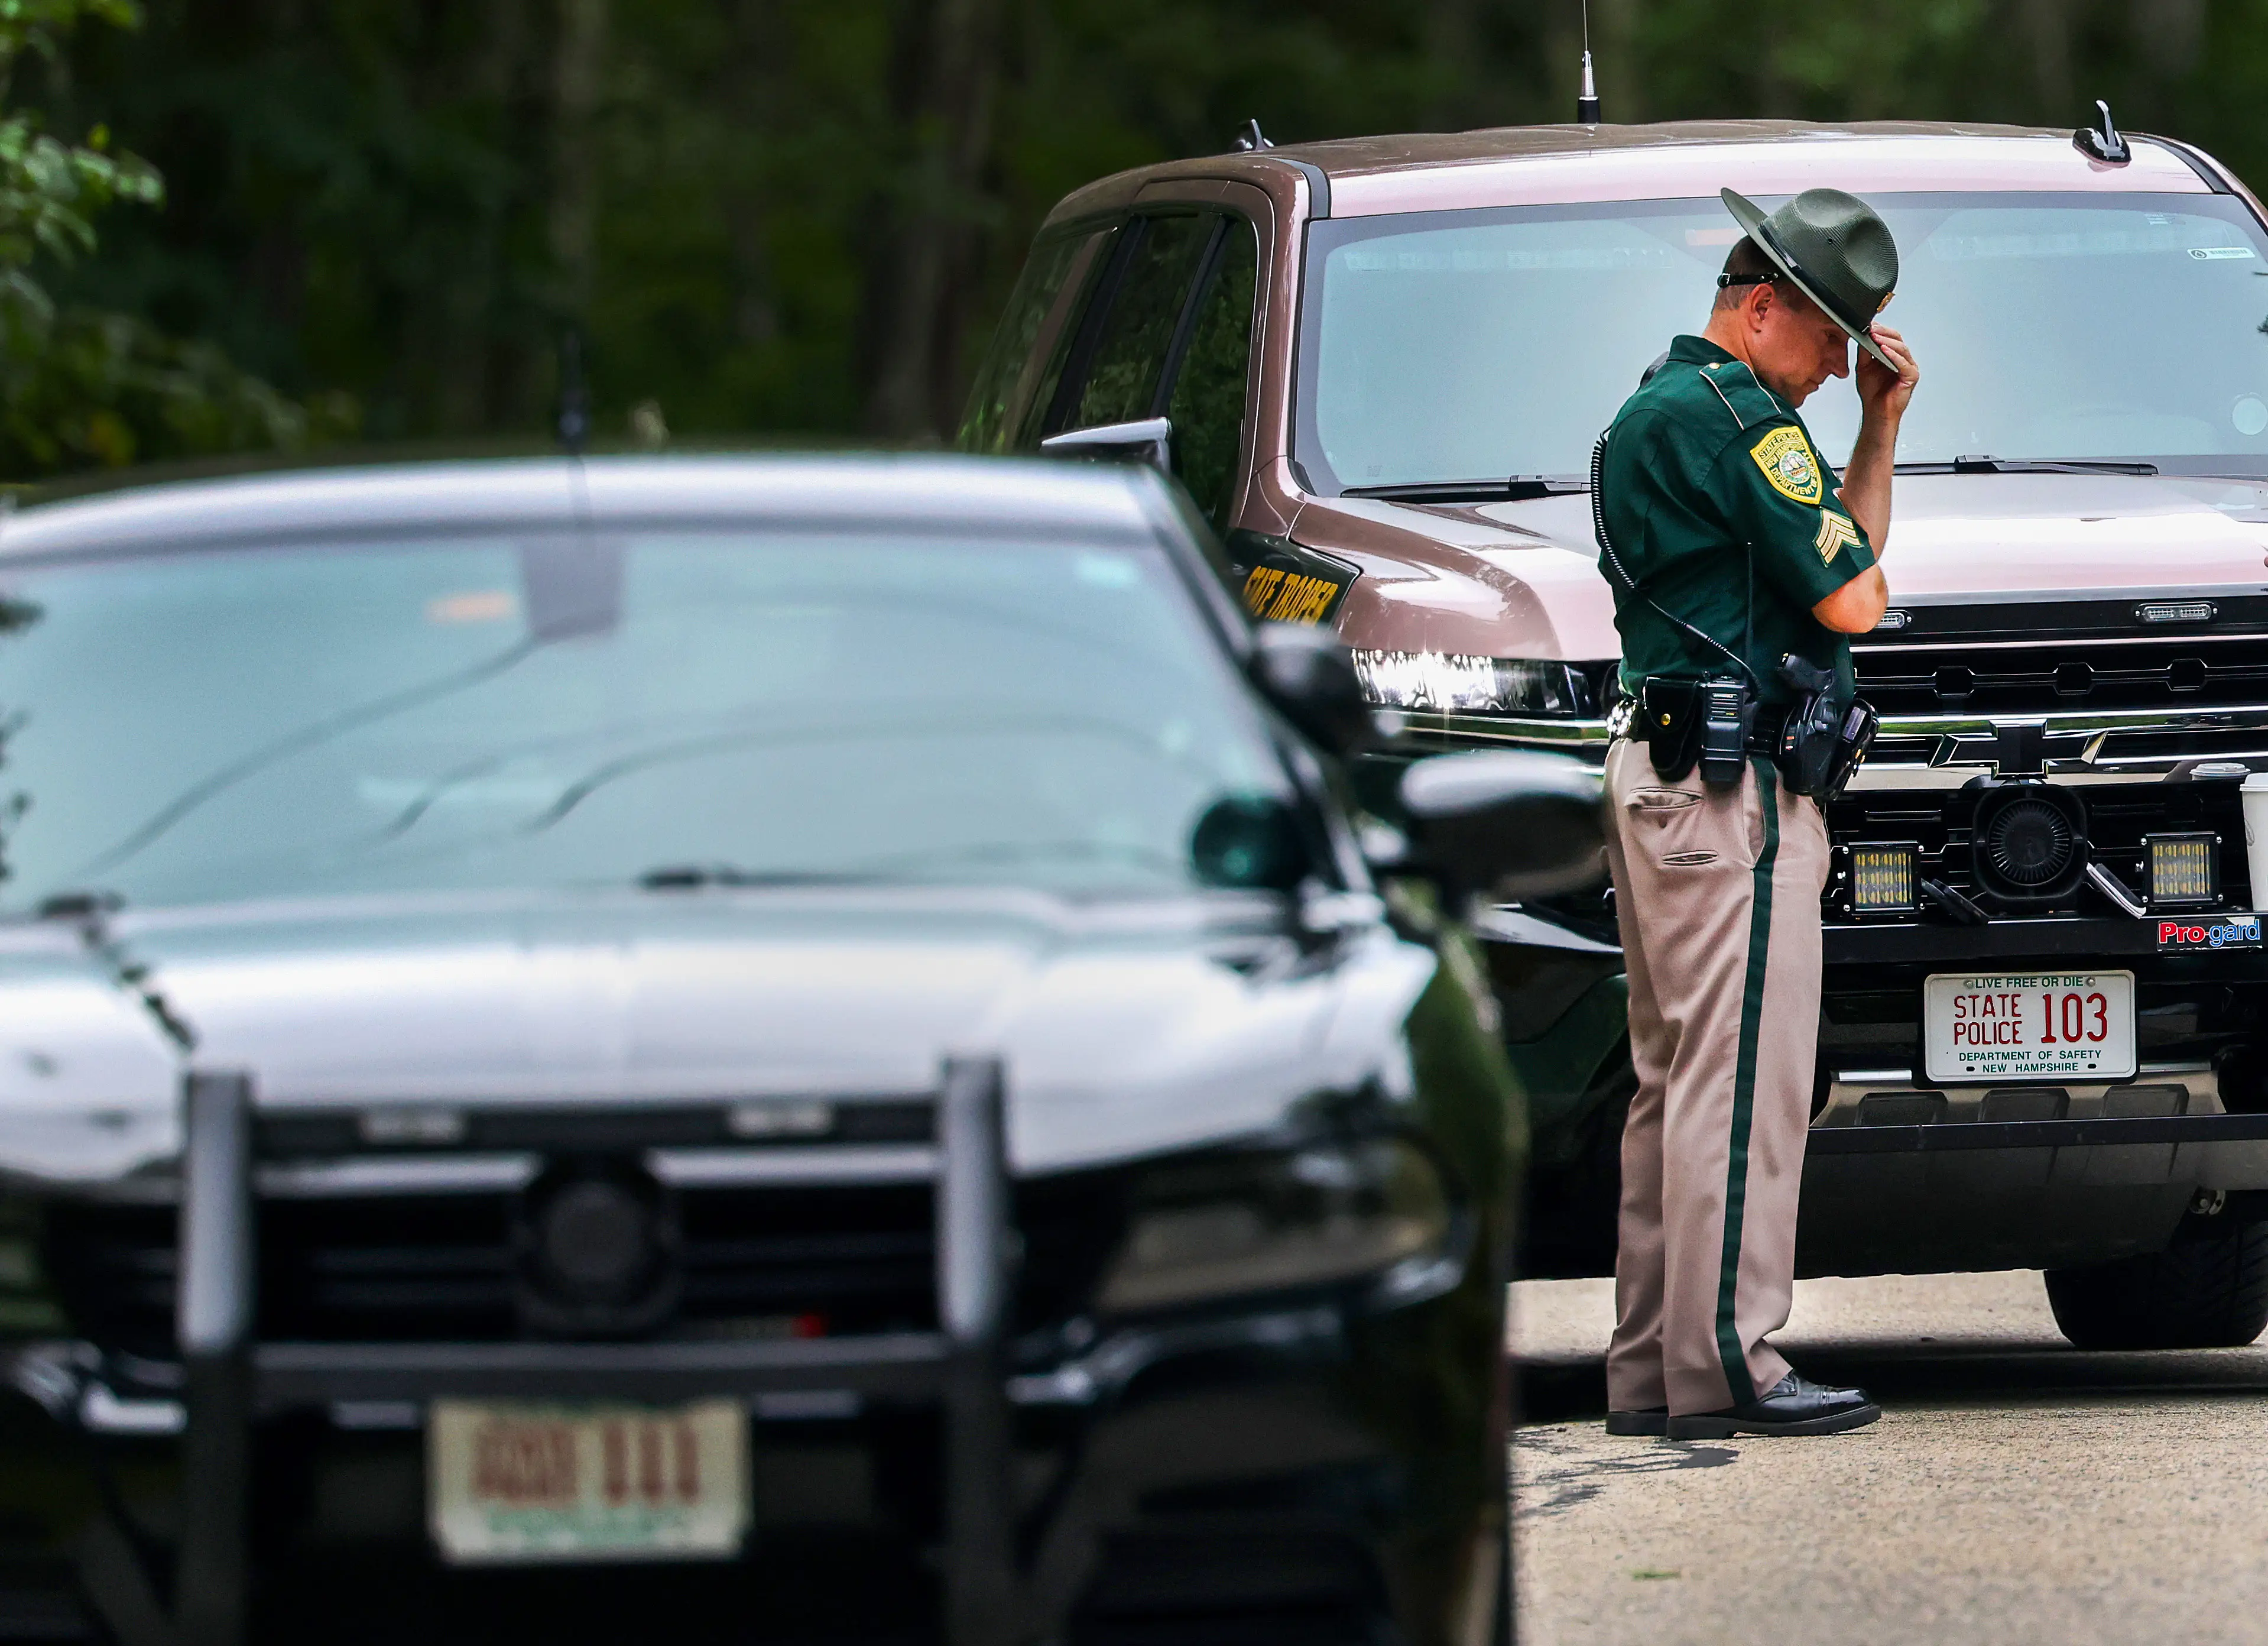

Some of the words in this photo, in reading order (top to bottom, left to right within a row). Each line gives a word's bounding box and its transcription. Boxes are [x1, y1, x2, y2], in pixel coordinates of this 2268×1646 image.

[1776, 432, 1800, 443] POLICE
[1771, 467, 1815, 495] DEPARTMENT
[2159, 919, 2260, 947] Pro-gard
[1975, 978, 2002, 989] LIVE
[2006, 977, 2037, 988] FREE
[2042, 977, 2059, 987] OR
[2063, 976, 2084, 987] DIE
[1954, 994, 2022, 1018] STATE
[2040, 992, 2108, 1044] 103
[1954, 1020, 2023, 1045] POLICE
[1959, 1051, 2032, 1061] DEPARTMENT
[2038, 1050, 2053, 1060] OF
[2059, 1049, 2102, 1059] SAFETY
[1983, 1063, 2007, 1073] NEW
[2016, 1062, 2079, 1072] HAMPSHIRE
